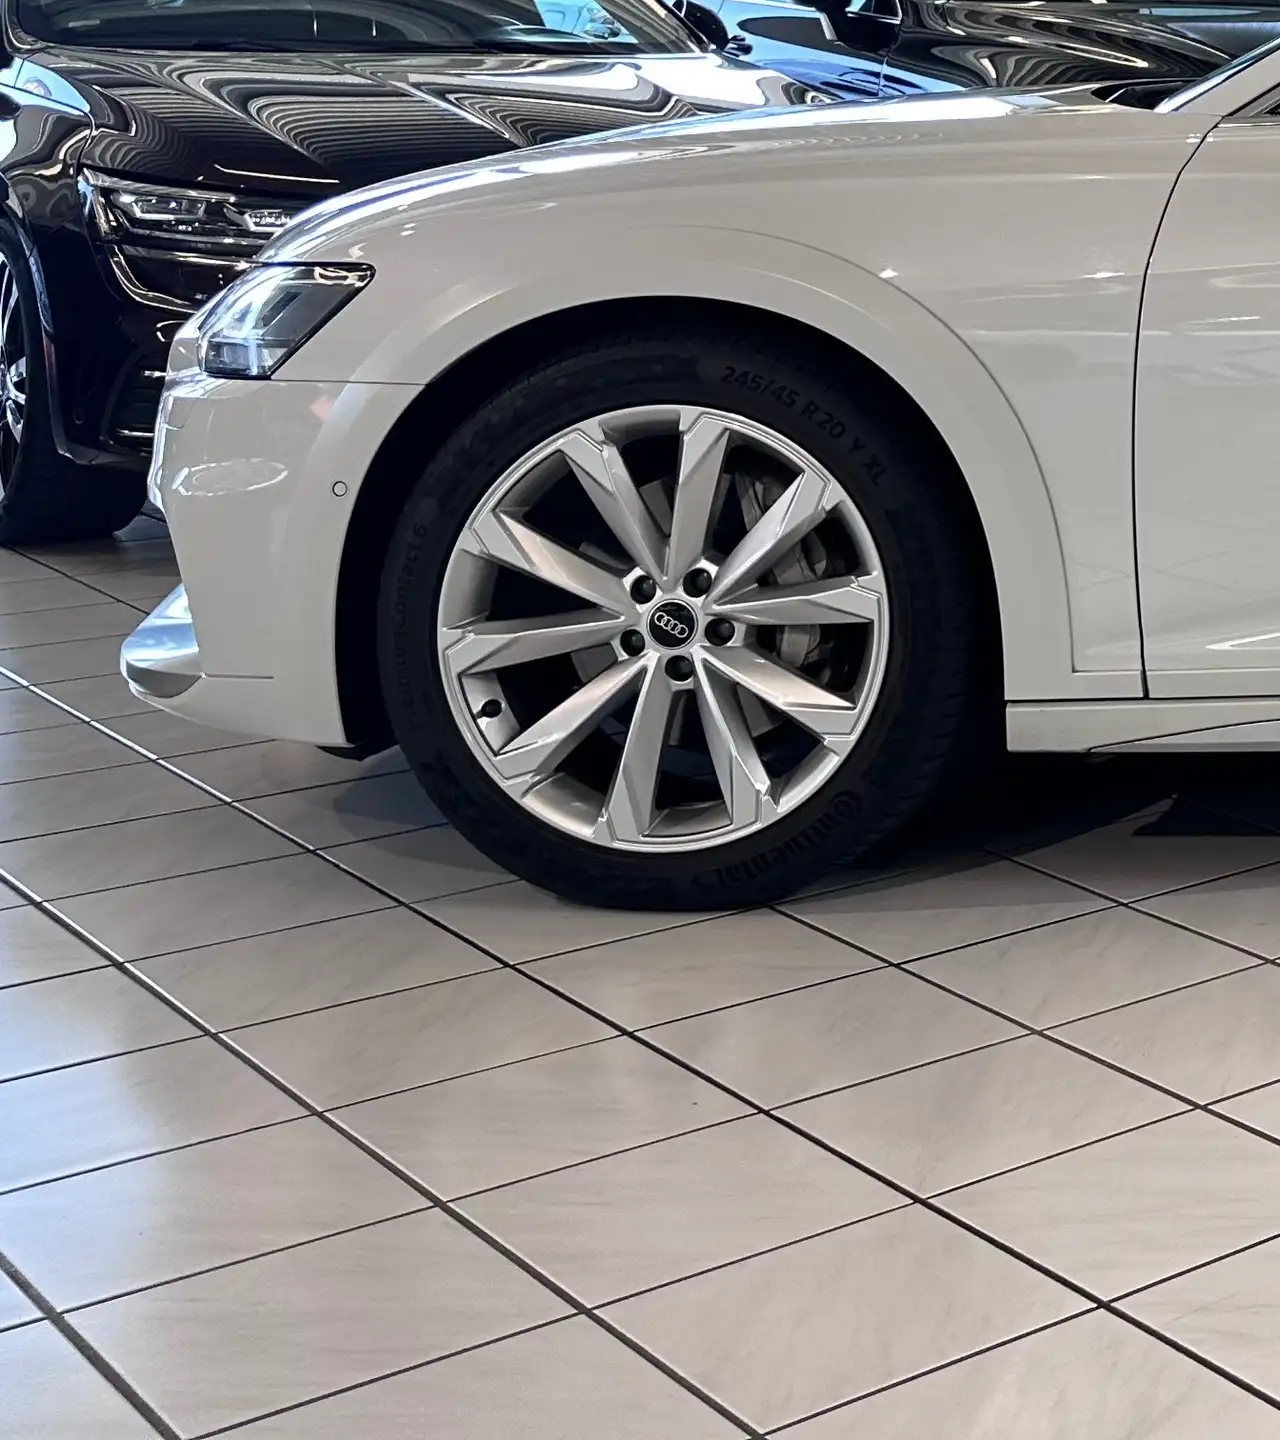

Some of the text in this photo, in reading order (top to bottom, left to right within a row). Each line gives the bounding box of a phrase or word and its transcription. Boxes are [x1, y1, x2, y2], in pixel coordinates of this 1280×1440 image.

[719, 365, 801, 409] 245/45
[846, 436, 867, 455] Y
[860, 453, 888, 487] XL
[713, 789, 863, 889] Continental
